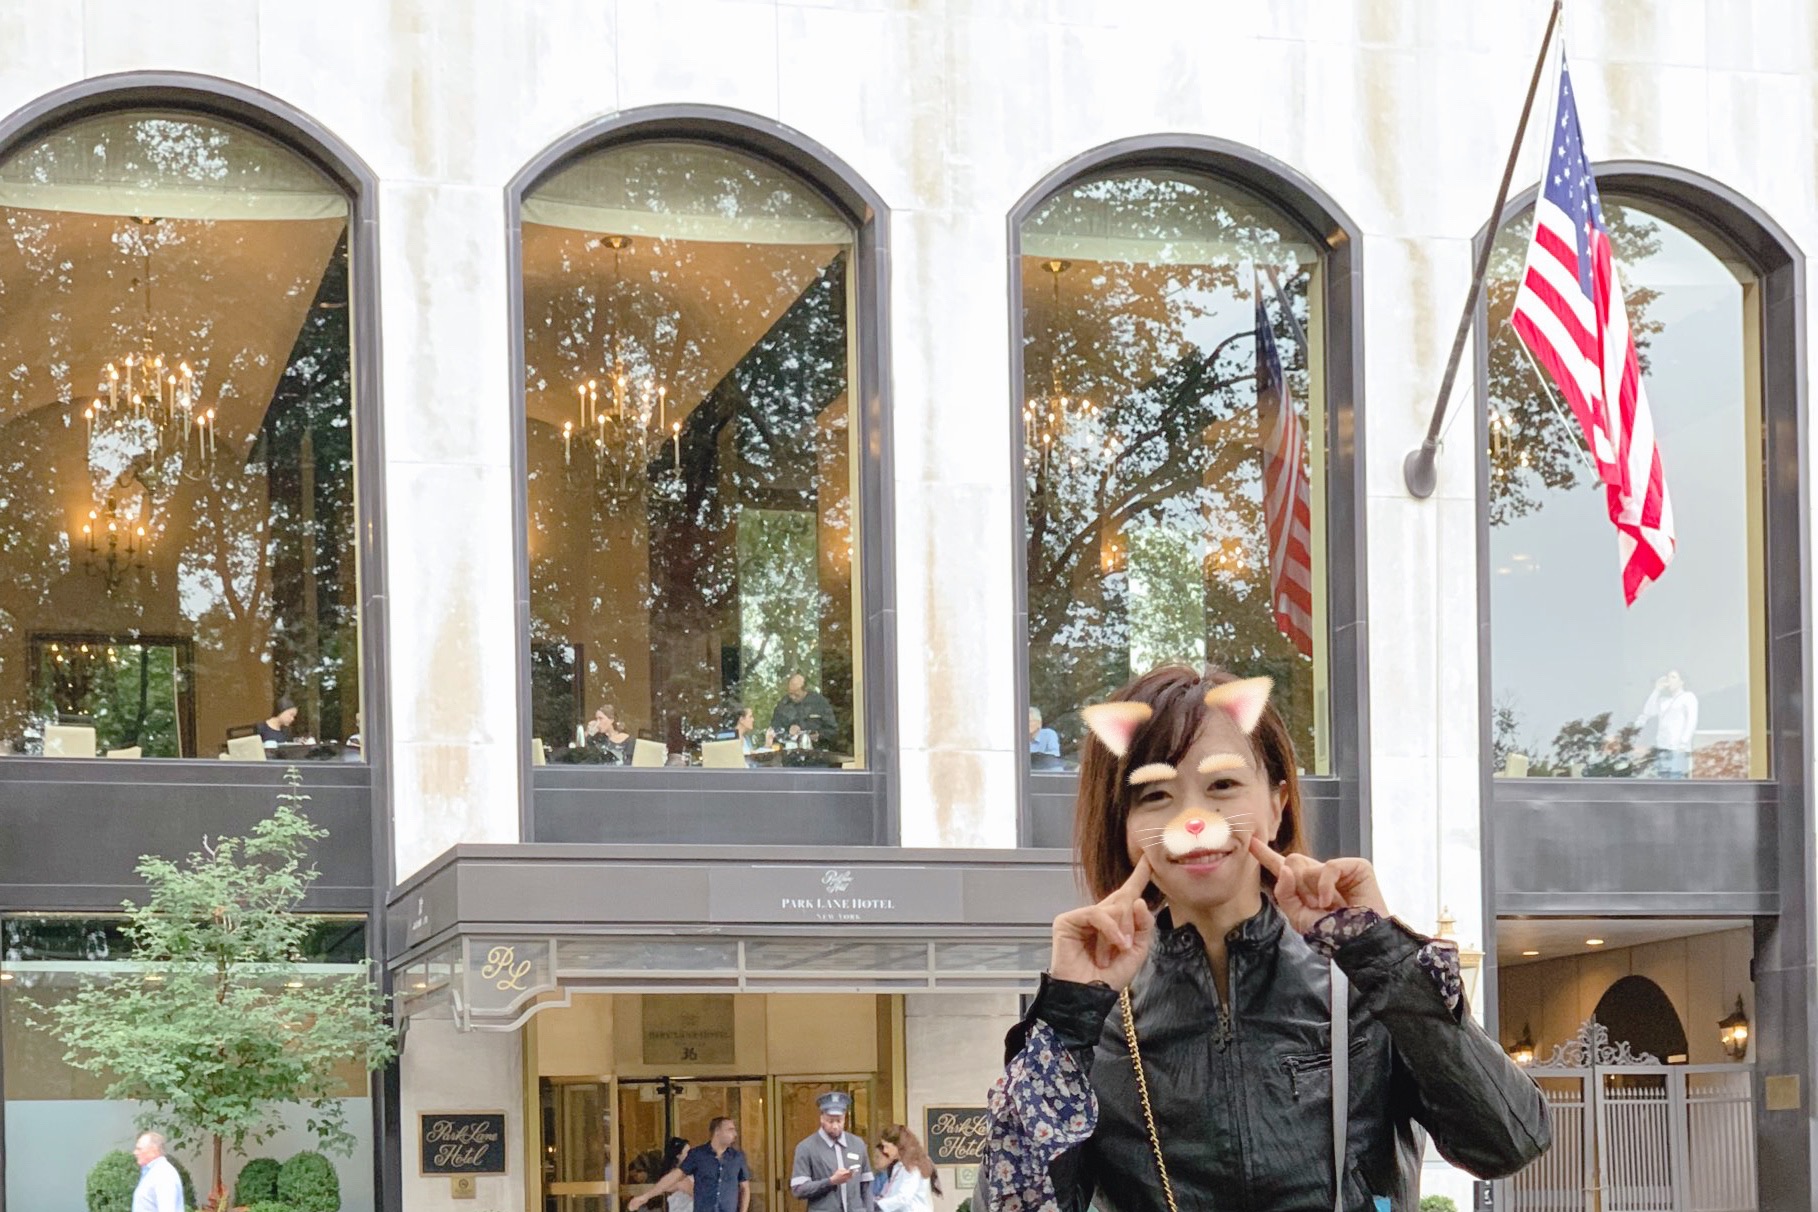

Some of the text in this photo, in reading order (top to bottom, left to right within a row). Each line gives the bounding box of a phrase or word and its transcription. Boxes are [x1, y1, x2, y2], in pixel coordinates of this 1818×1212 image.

[782, 898, 895, 909] PARK LANE HOTEL
[426, 1120, 470, 1144] Park
[931, 1113, 972, 1136] Park
[434, 1144, 490, 1168] Hotel
[939, 1136, 987, 1159] Hotel
